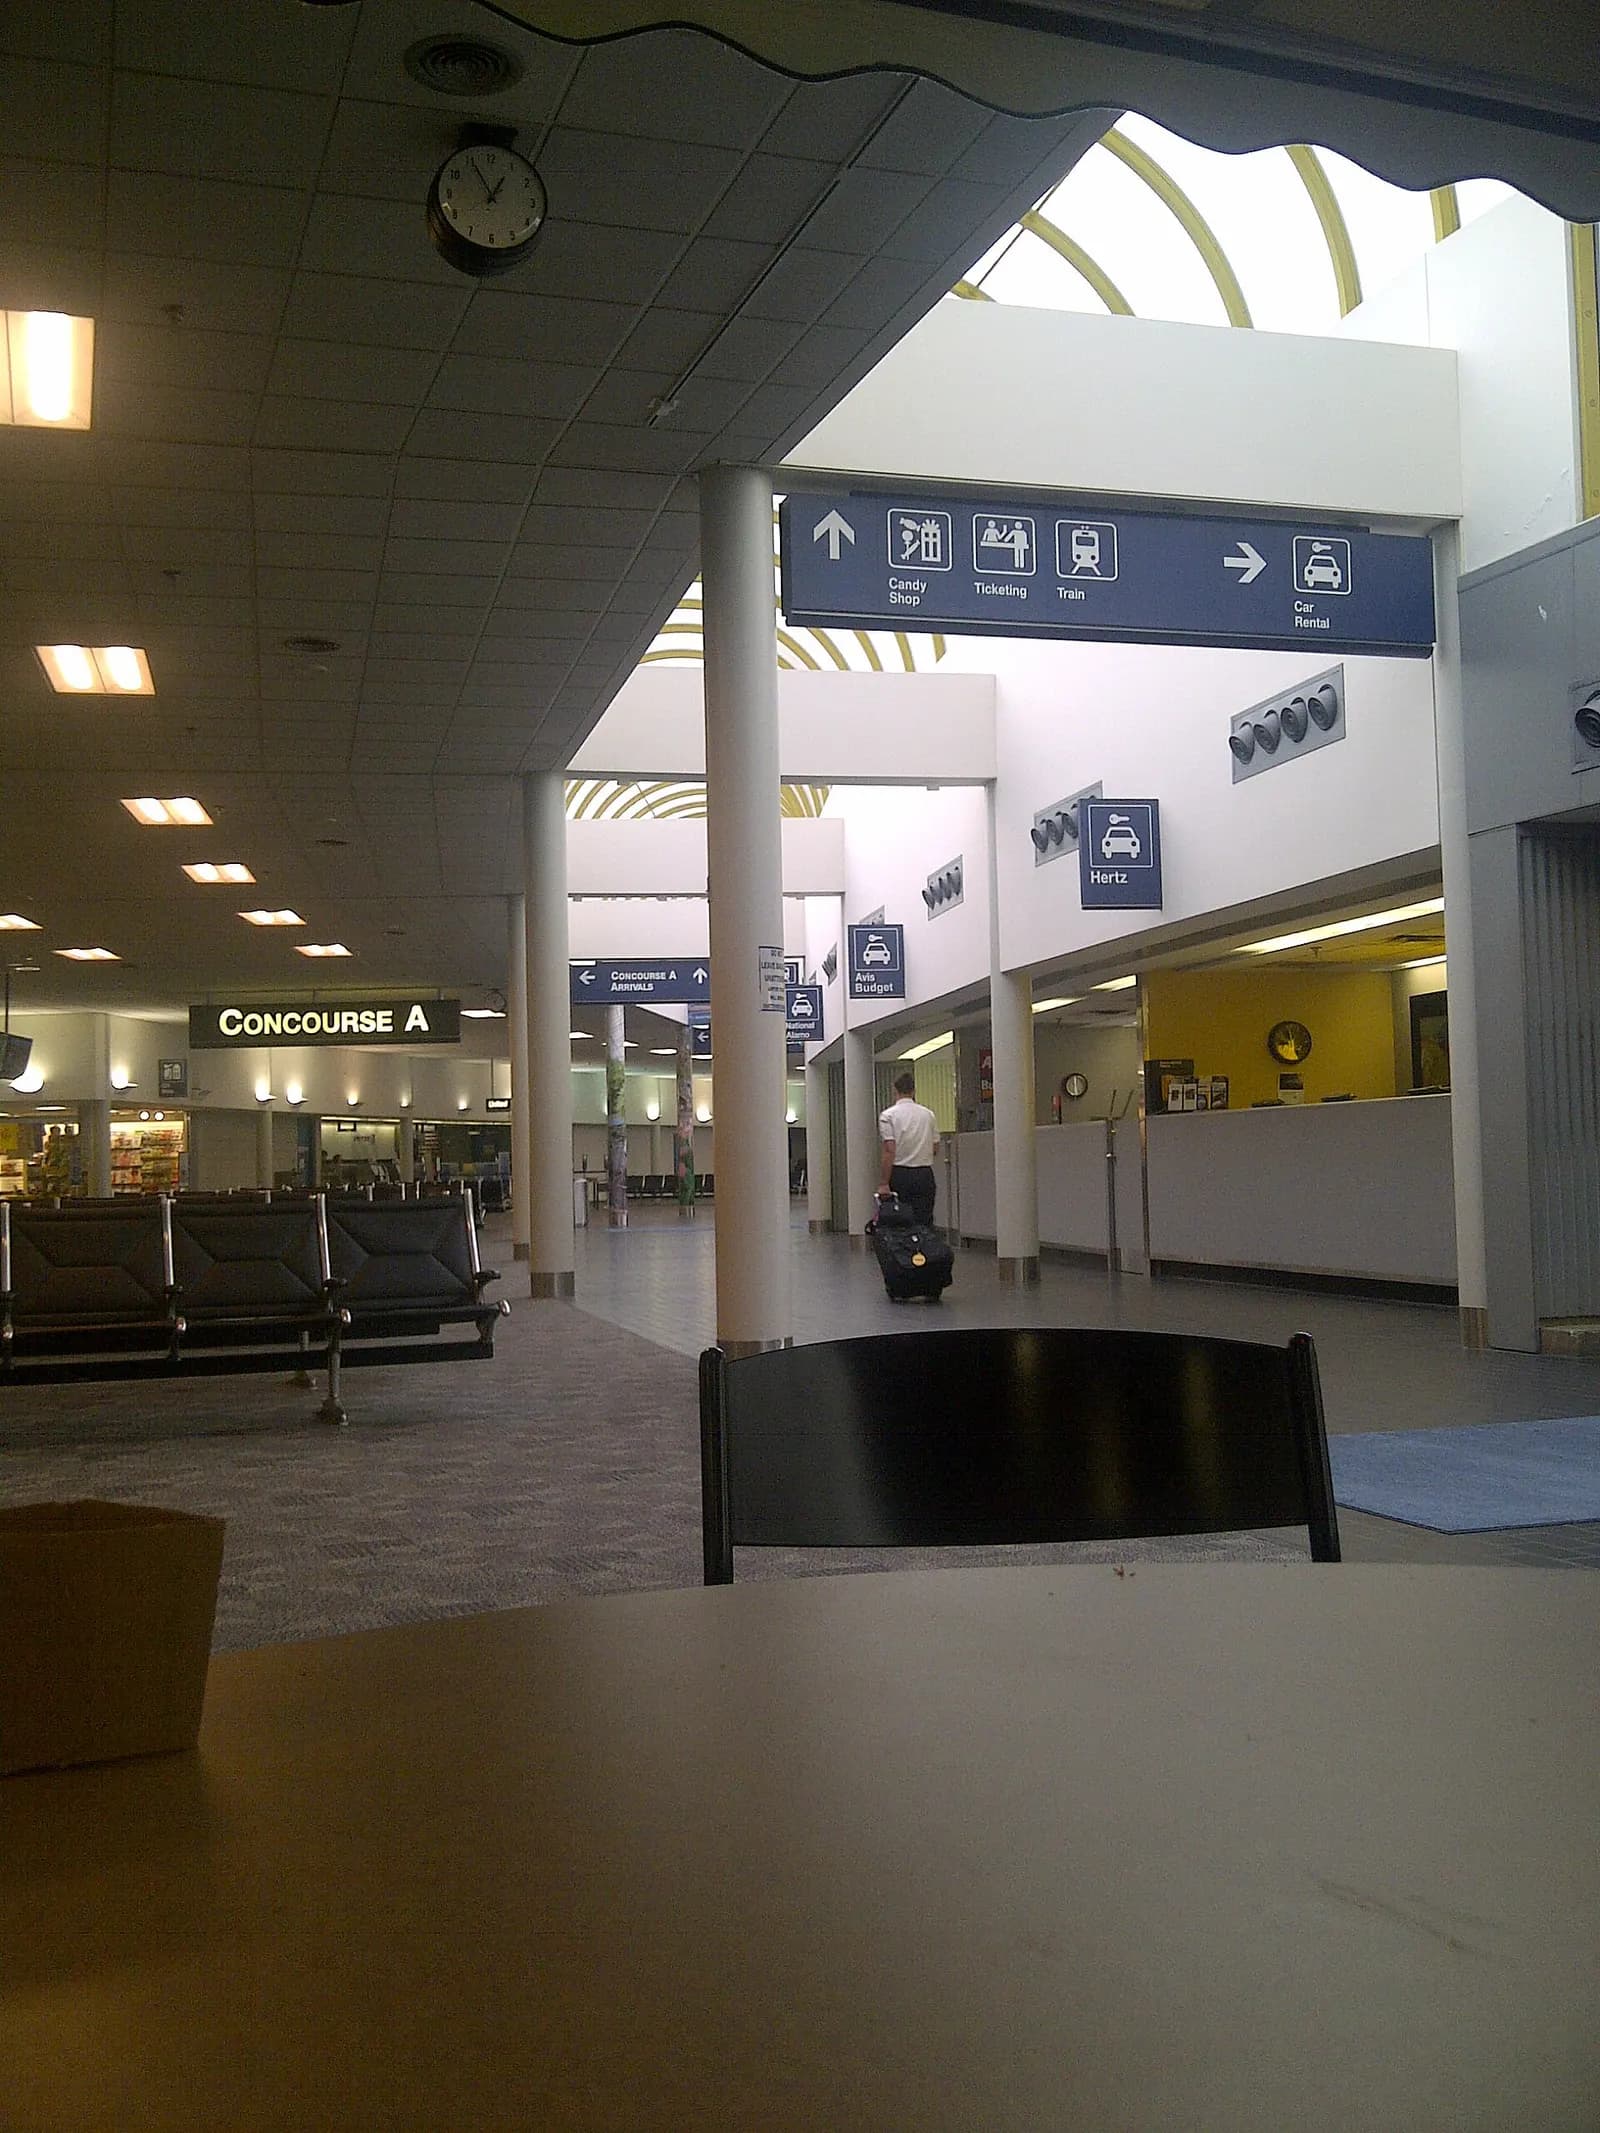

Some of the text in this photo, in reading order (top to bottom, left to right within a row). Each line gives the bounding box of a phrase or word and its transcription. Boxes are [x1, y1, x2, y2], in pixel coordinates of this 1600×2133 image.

[888, 576, 928, 594] Candy
[974, 583, 1028, 599] Ticketing
[889, 592, 921, 607] Shop
[1056, 587, 1086, 601] Train
[1294, 600, 1315, 613] Car
[1294, 615, 1331, 629] Rental
[1090, 870, 1129, 885] Hertz
[610, 970, 677, 981] CONCOURSE A
[855, 972, 875, 982] Avis
[610, 982, 655, 992] ARRIVALS
[855, 982, 894, 995] Budget
[218, 1004, 430, 1036] CONCOURSE A
